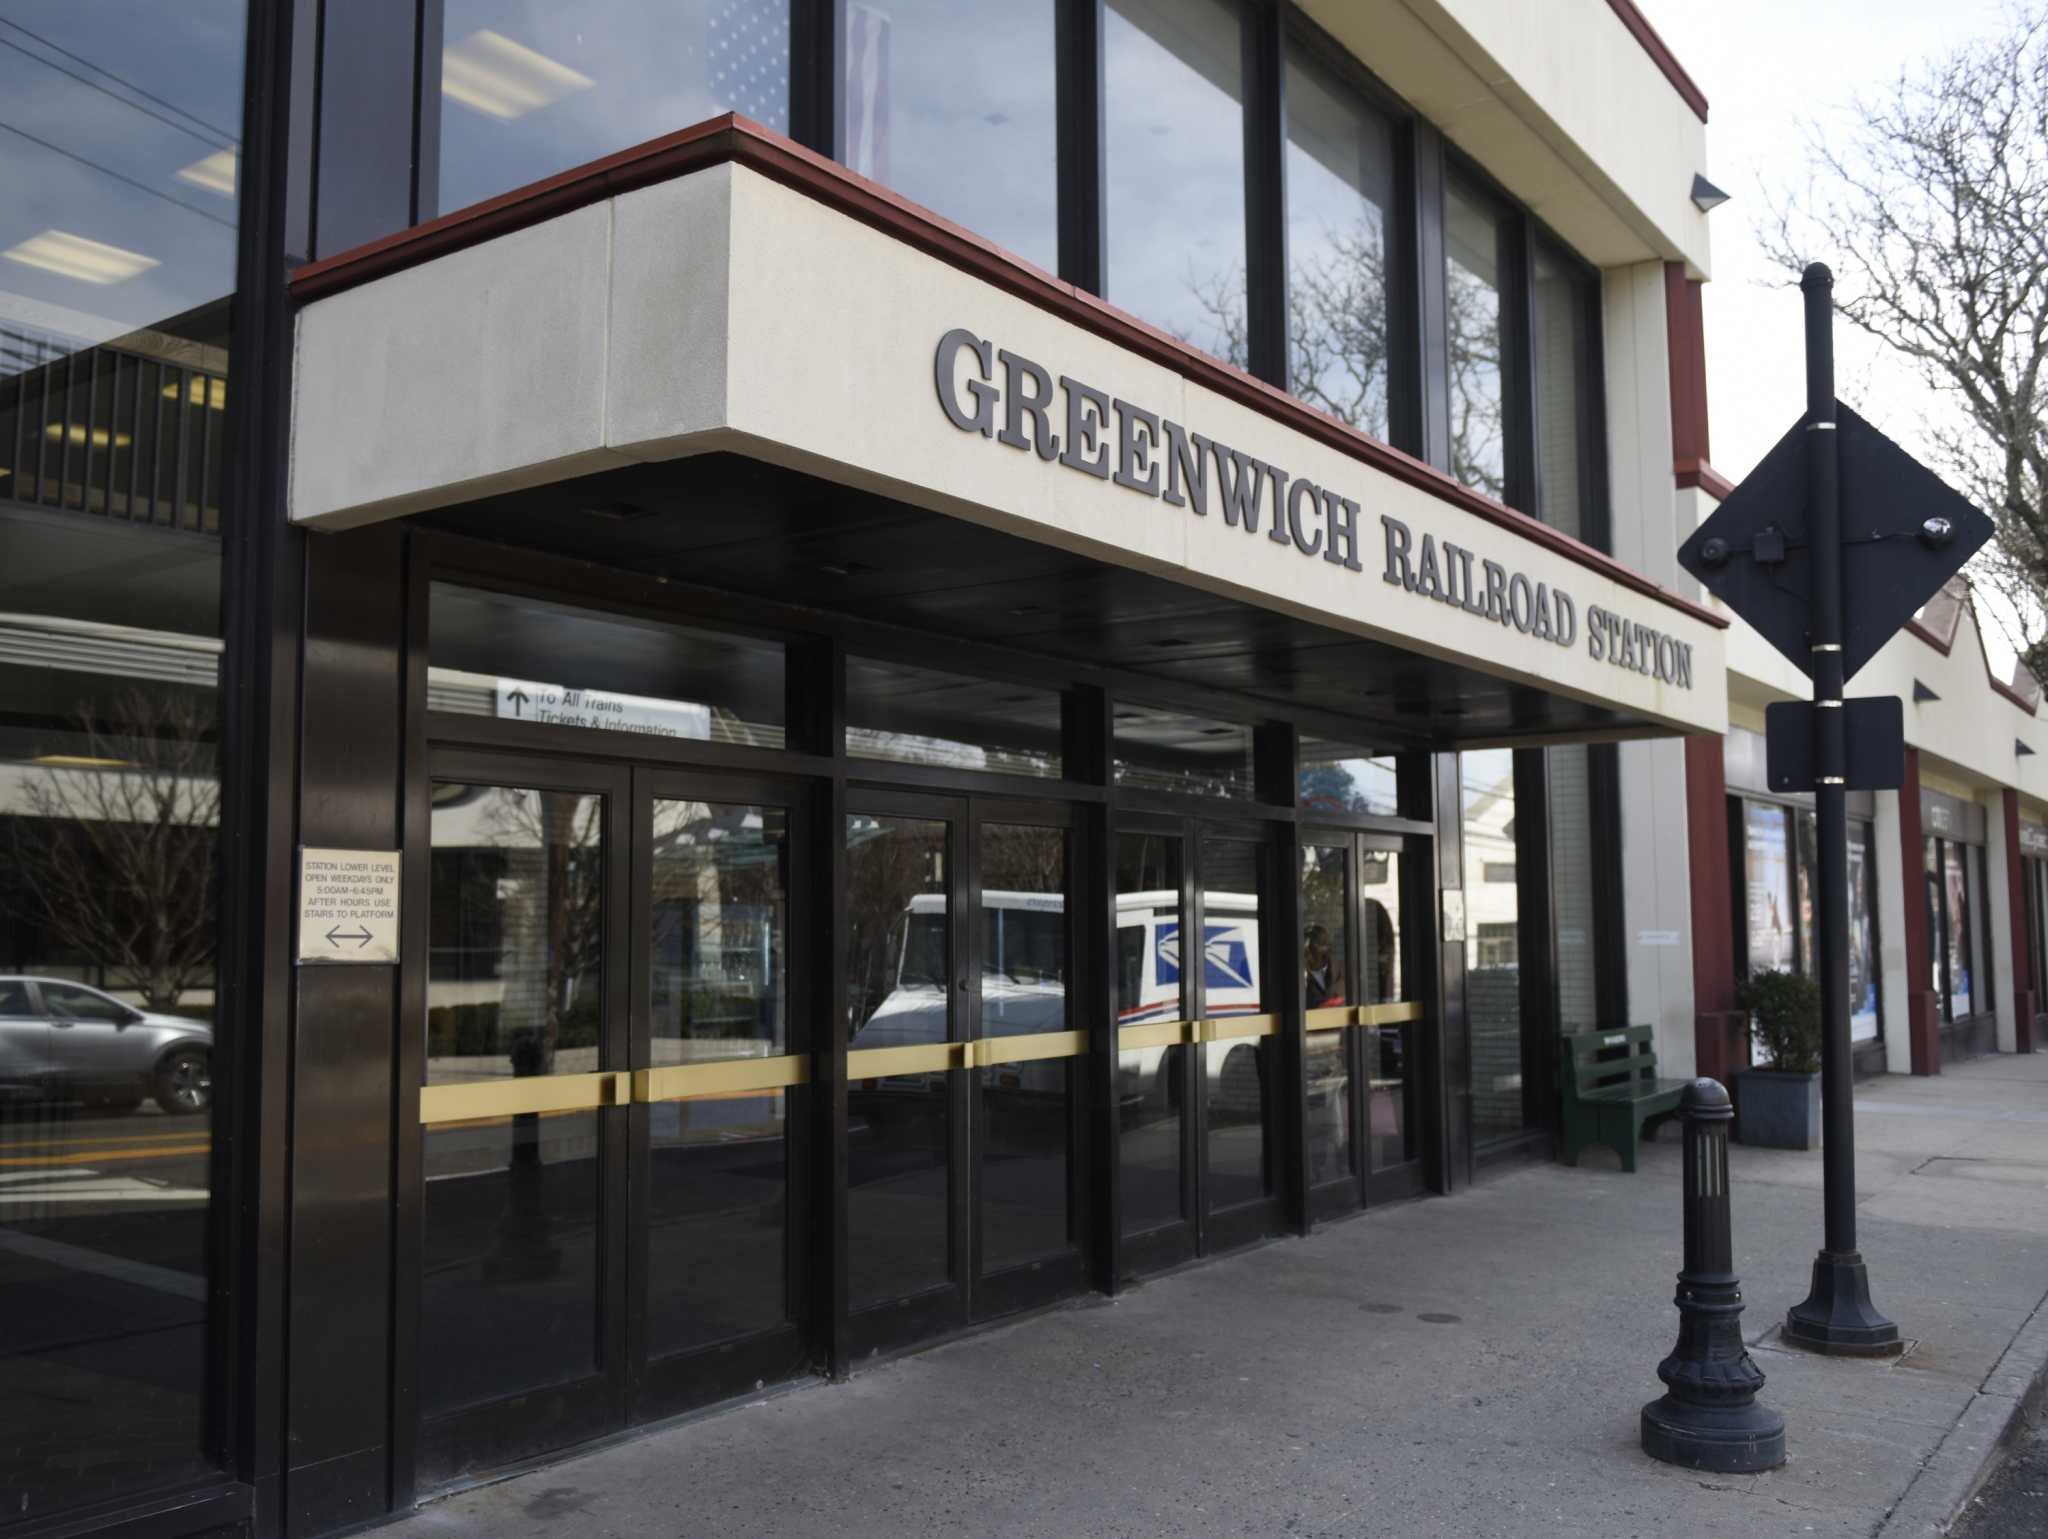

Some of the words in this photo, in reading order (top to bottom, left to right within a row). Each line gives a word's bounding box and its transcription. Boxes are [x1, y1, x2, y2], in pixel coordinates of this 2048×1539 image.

[935, 328, 1362, 572] GREENWICH
[1380, 513, 1577, 648] RAILROAD
[1587, 604, 1694, 690] STATION
[562, 692, 580, 708] All
[540, 710, 587, 728] Tickets
[591, 717, 600, 729] &
[305, 862, 338, 870] STATION
[341, 863, 368, 872] LOWER
[371, 864, 394, 872] LEVEL
[304, 873, 328, 882] OPEN
[331, 874, 373, 884] WEEKDAYS
[376, 875, 394, 884] ONLY
[308, 897, 337, 906] AFTER
[340, 898, 370, 907] HOURS
[374, 899, 392, 907] USE
[304, 910, 335, 919] STAIRS
[337, 910, 348, 918] TO
[351, 910, 394, 919] PLATFORM
